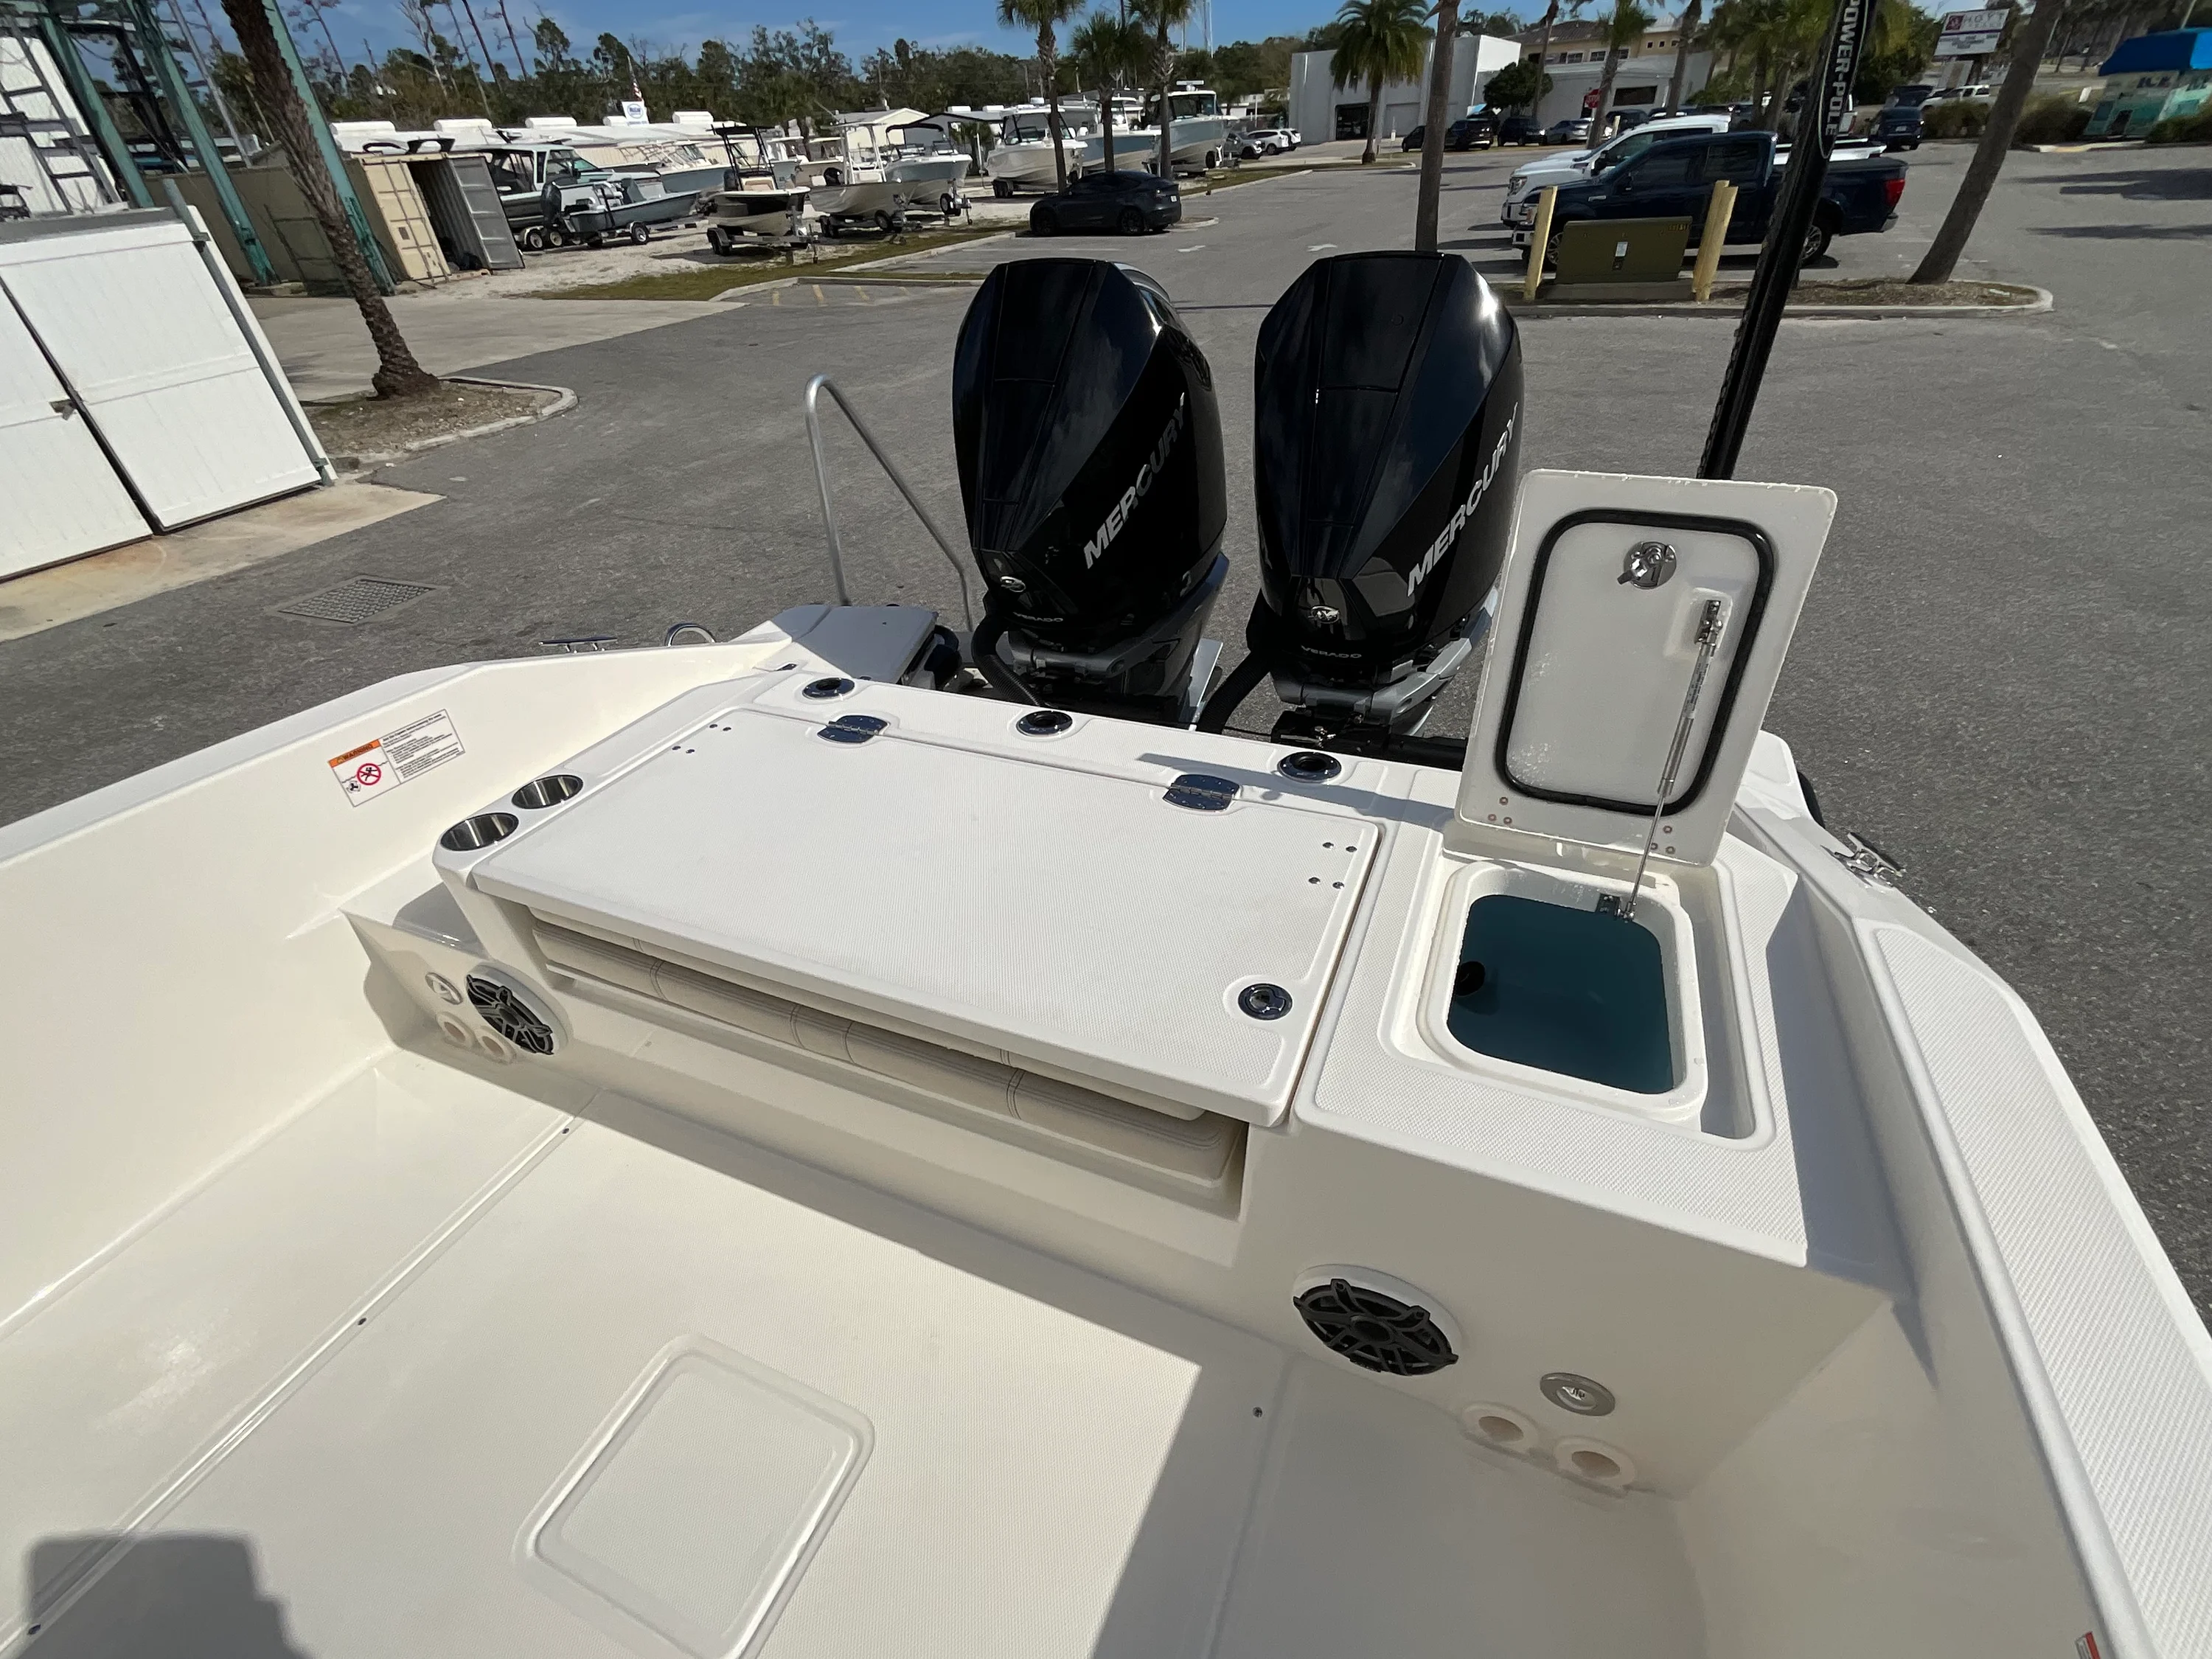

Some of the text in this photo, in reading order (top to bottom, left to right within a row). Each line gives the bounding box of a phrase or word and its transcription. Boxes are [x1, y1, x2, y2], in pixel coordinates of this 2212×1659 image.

[1083, 392, 1185, 569] MERCURY
[1407, 402, 1518, 597] MERCURY
[1300, 645, 1362, 658] VERADO
